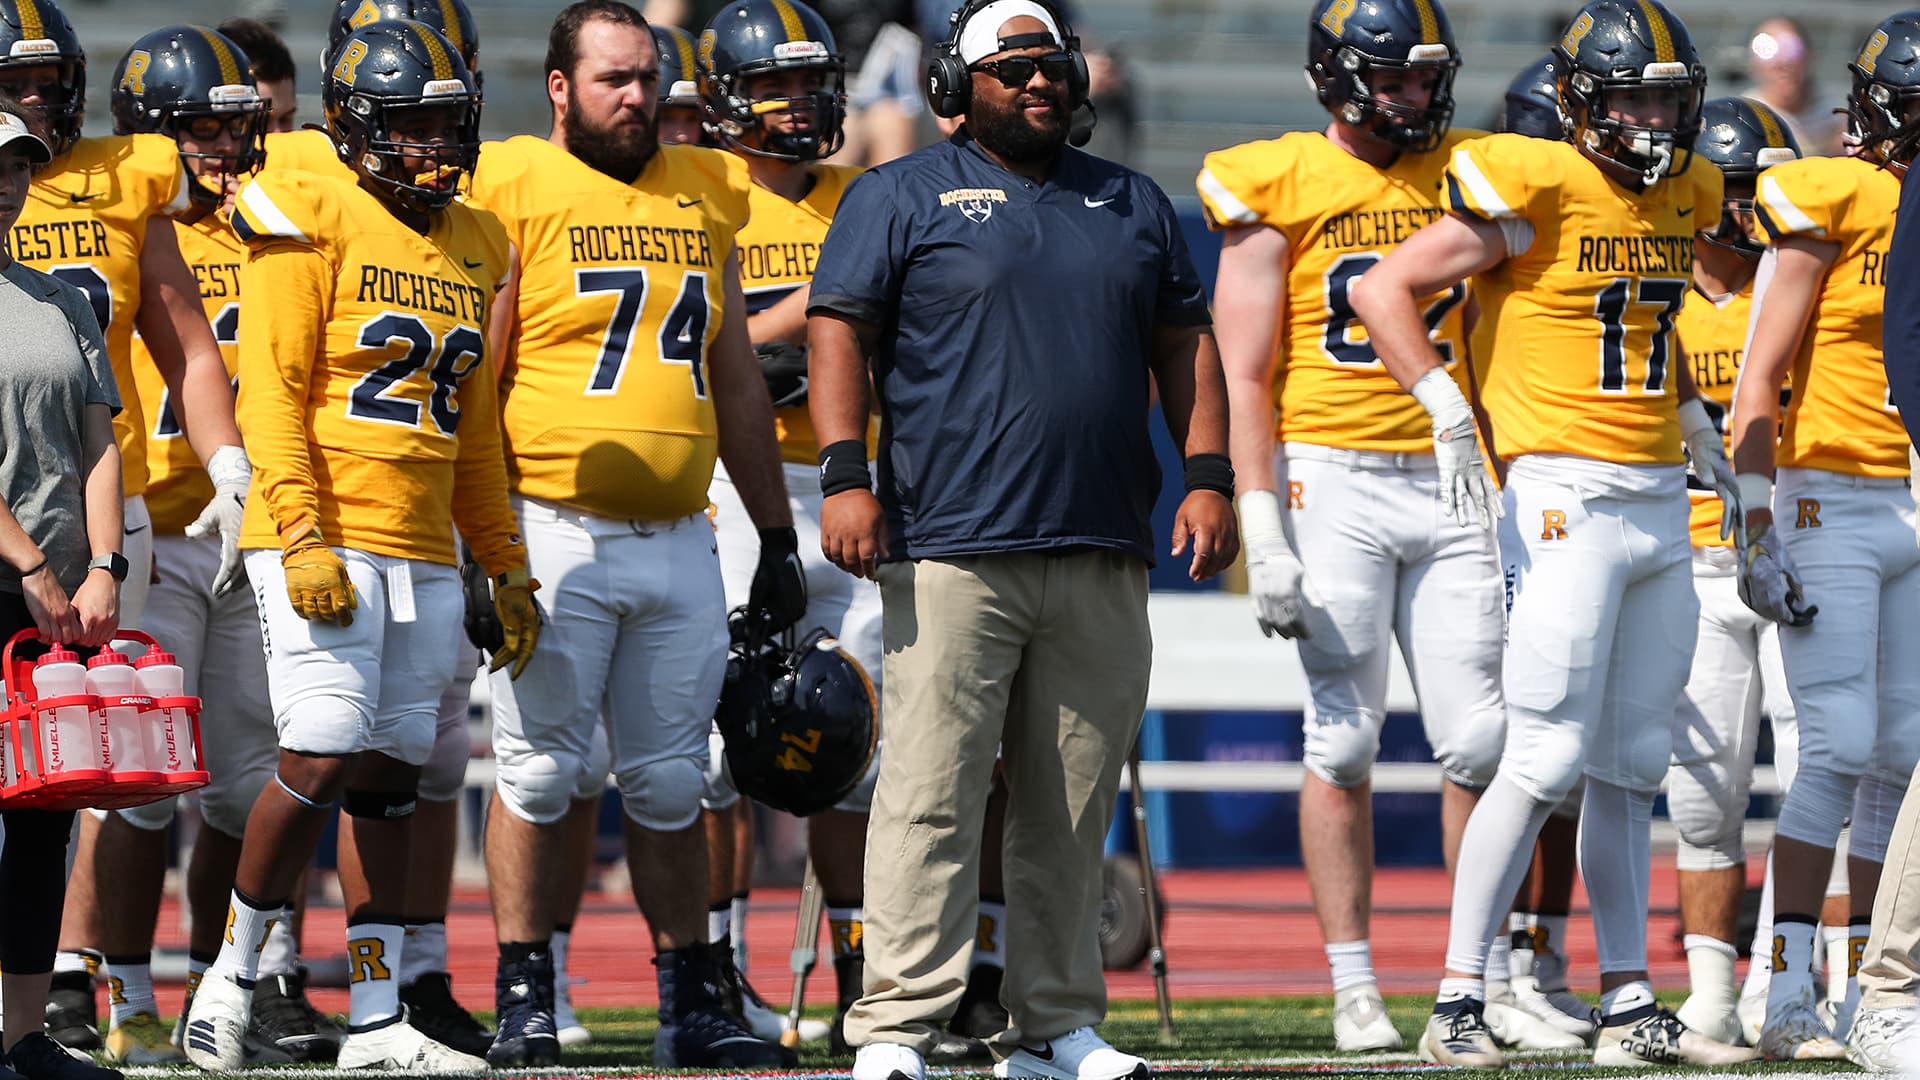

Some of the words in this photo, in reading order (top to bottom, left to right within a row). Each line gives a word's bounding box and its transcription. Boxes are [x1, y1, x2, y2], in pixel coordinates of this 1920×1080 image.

[1561, 12, 1594, 59] R
[121, 50, 151, 95] R
[333, 39, 368, 86] R
[3, 220, 111, 261] ESTER
[568, 225, 714, 268] ROCHESTER
[574, 265, 708, 401] 74
[1593, 277, 1688, 395] 17
[345, 310, 484, 437] 28
[1287, 481, 1305, 510] R
[1796, 499, 1822, 528] R
[1541, 510, 1568, 540] R
[347, 937, 395, 984] R
